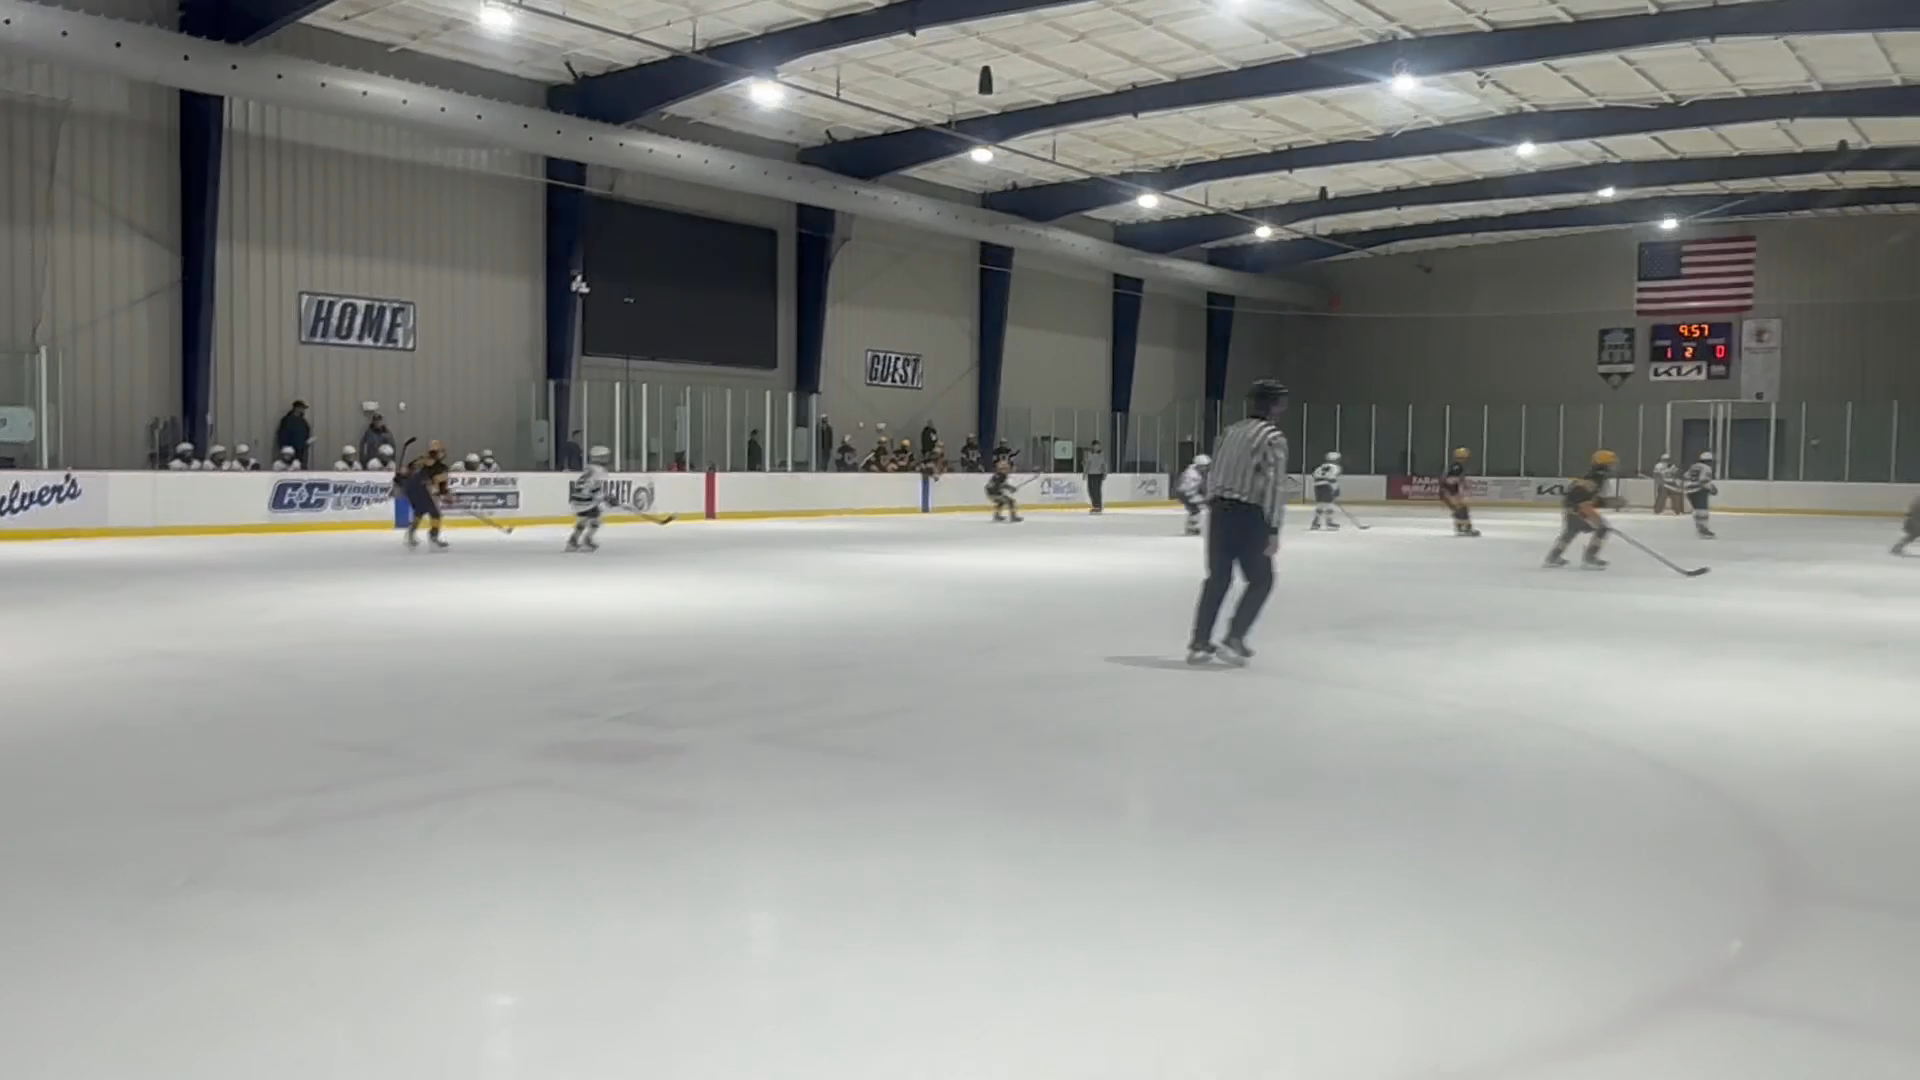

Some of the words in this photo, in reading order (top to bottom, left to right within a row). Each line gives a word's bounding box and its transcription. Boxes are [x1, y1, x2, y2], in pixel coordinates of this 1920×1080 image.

[310, 299, 405, 344] HOME
[1679, 324, 1708, 337] 9:57
[1666, 347, 1672, 358] 1
[1684, 347, 1694, 358] 2
[1715, 345, 1726, 358] 0
[869, 354, 920, 385] GUEST
[1653, 365, 1702, 377] KIA
